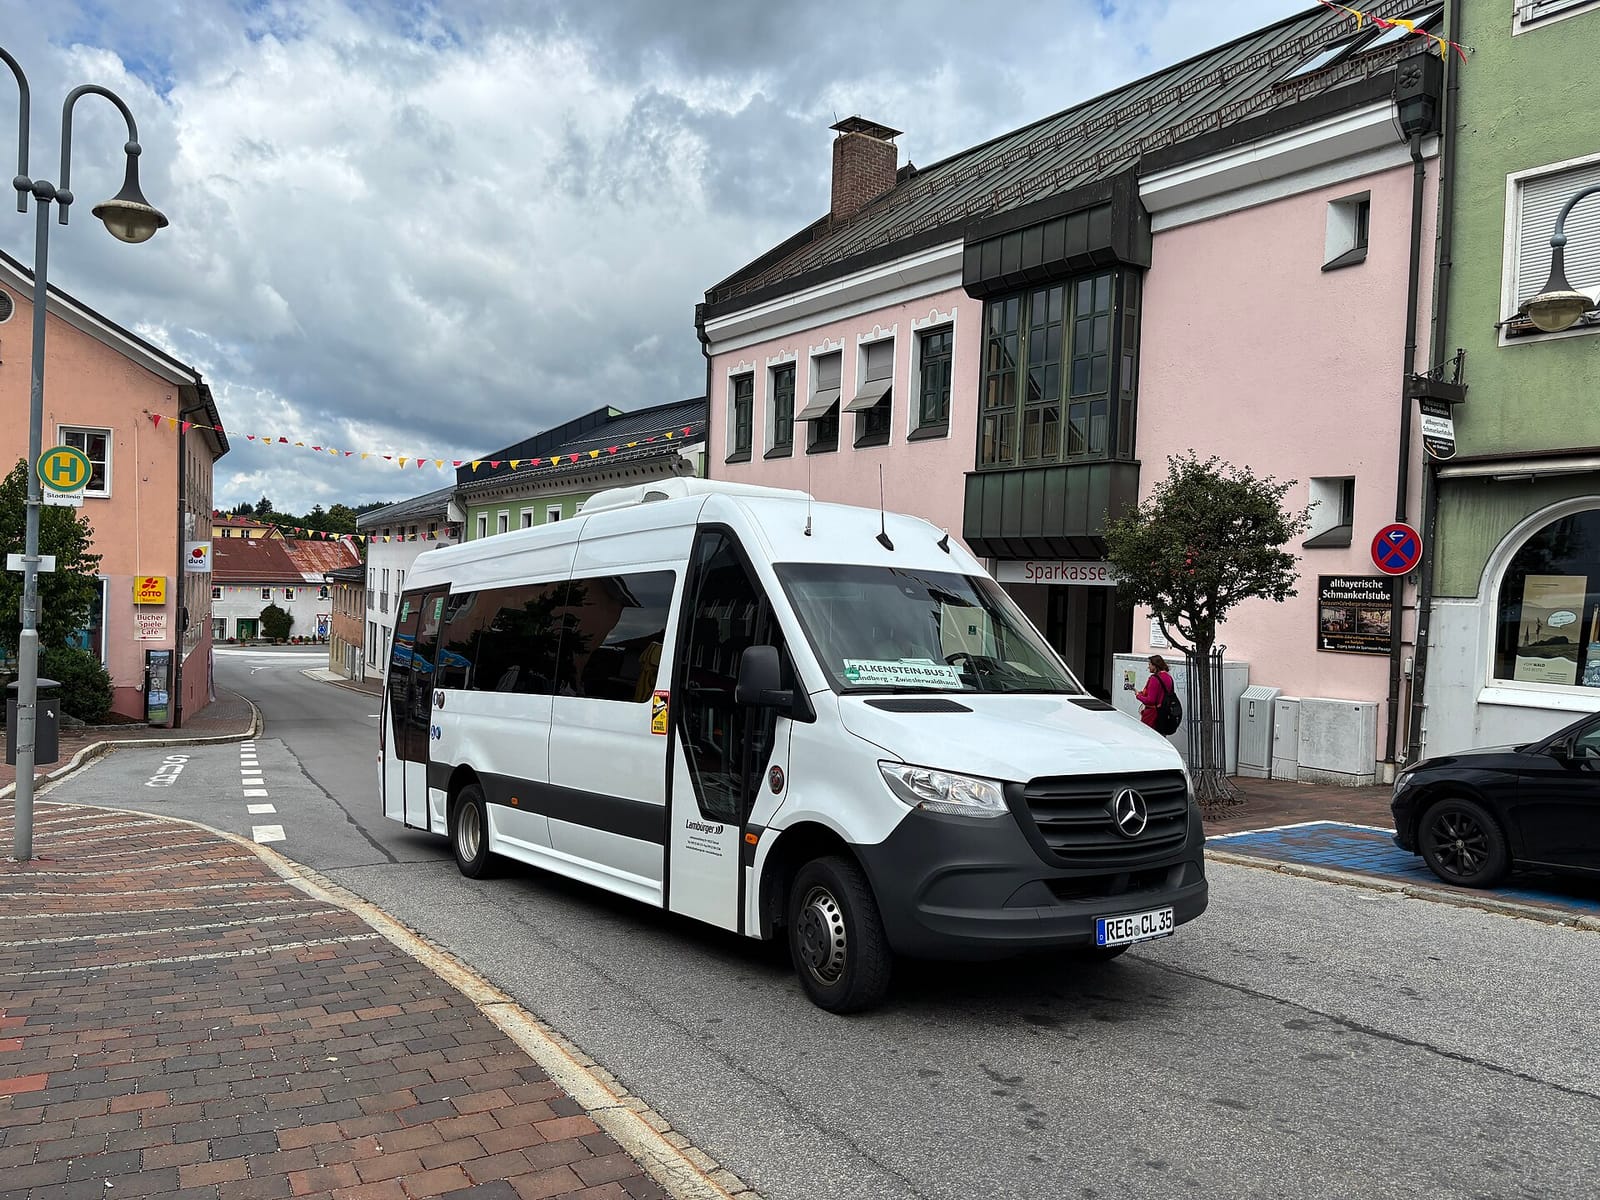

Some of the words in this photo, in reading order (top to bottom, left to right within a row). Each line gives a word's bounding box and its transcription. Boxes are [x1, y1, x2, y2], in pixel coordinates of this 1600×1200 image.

[52, 456, 78, 482] H
[188, 557, 204, 565] duo
[1025, 560, 1107, 584] Sparkasse
[1330, 578, 1384, 590] altbayerische
[137, 590, 162, 598] LOTTO
[1322, 589, 1391, 601] Schmankerlstube
[139, 620, 162, 629] Spiele
[1106, 918, 1133, 941] REG
[1141, 914, 1157, 934] CL
[1159, 910, 1172, 931] 35
